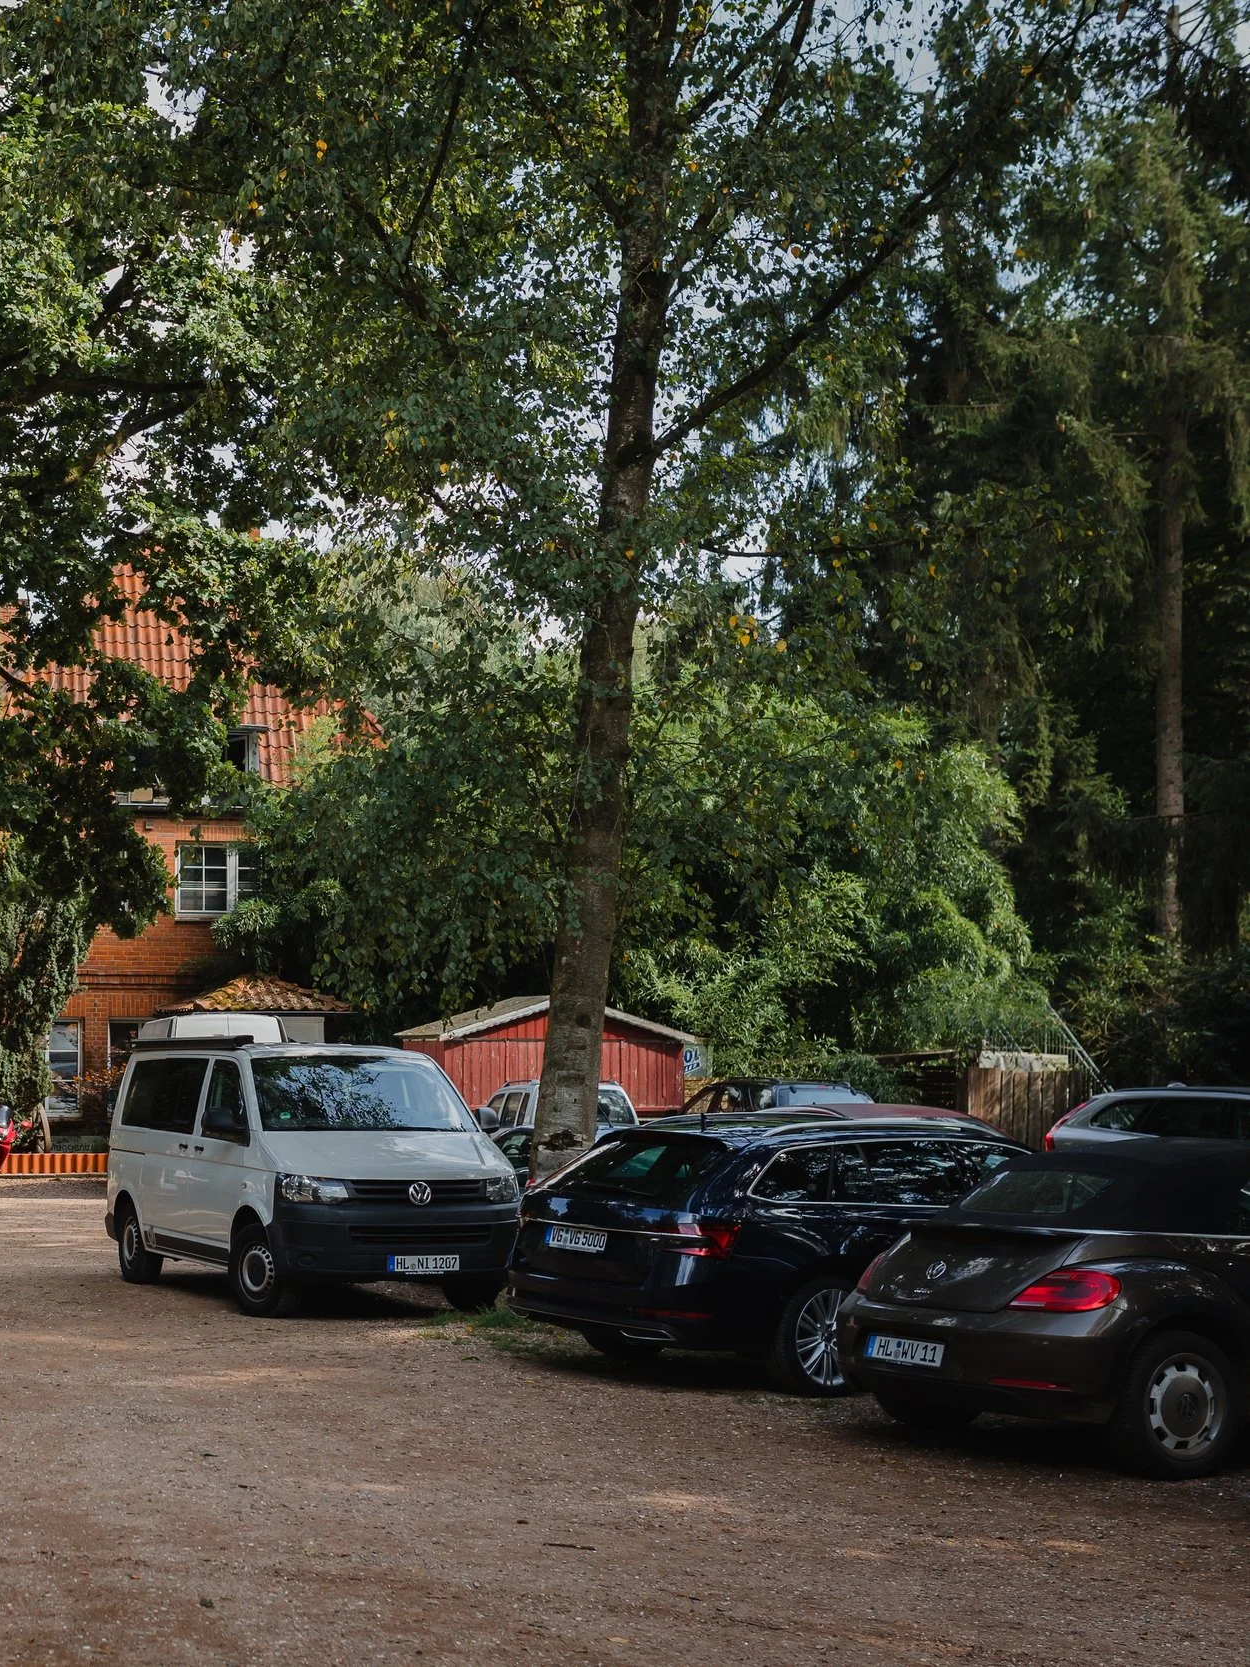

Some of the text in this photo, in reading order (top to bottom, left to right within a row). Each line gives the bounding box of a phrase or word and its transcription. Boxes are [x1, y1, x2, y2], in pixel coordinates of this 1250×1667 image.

[552, 1227, 564, 1243] VG
[569, 1230, 582, 1245] VG
[581, 1231, 606, 1249] 5000
[396, 1257, 457, 1270] HL NI 1207
[876, 1338, 937, 1363] HL WV 11
